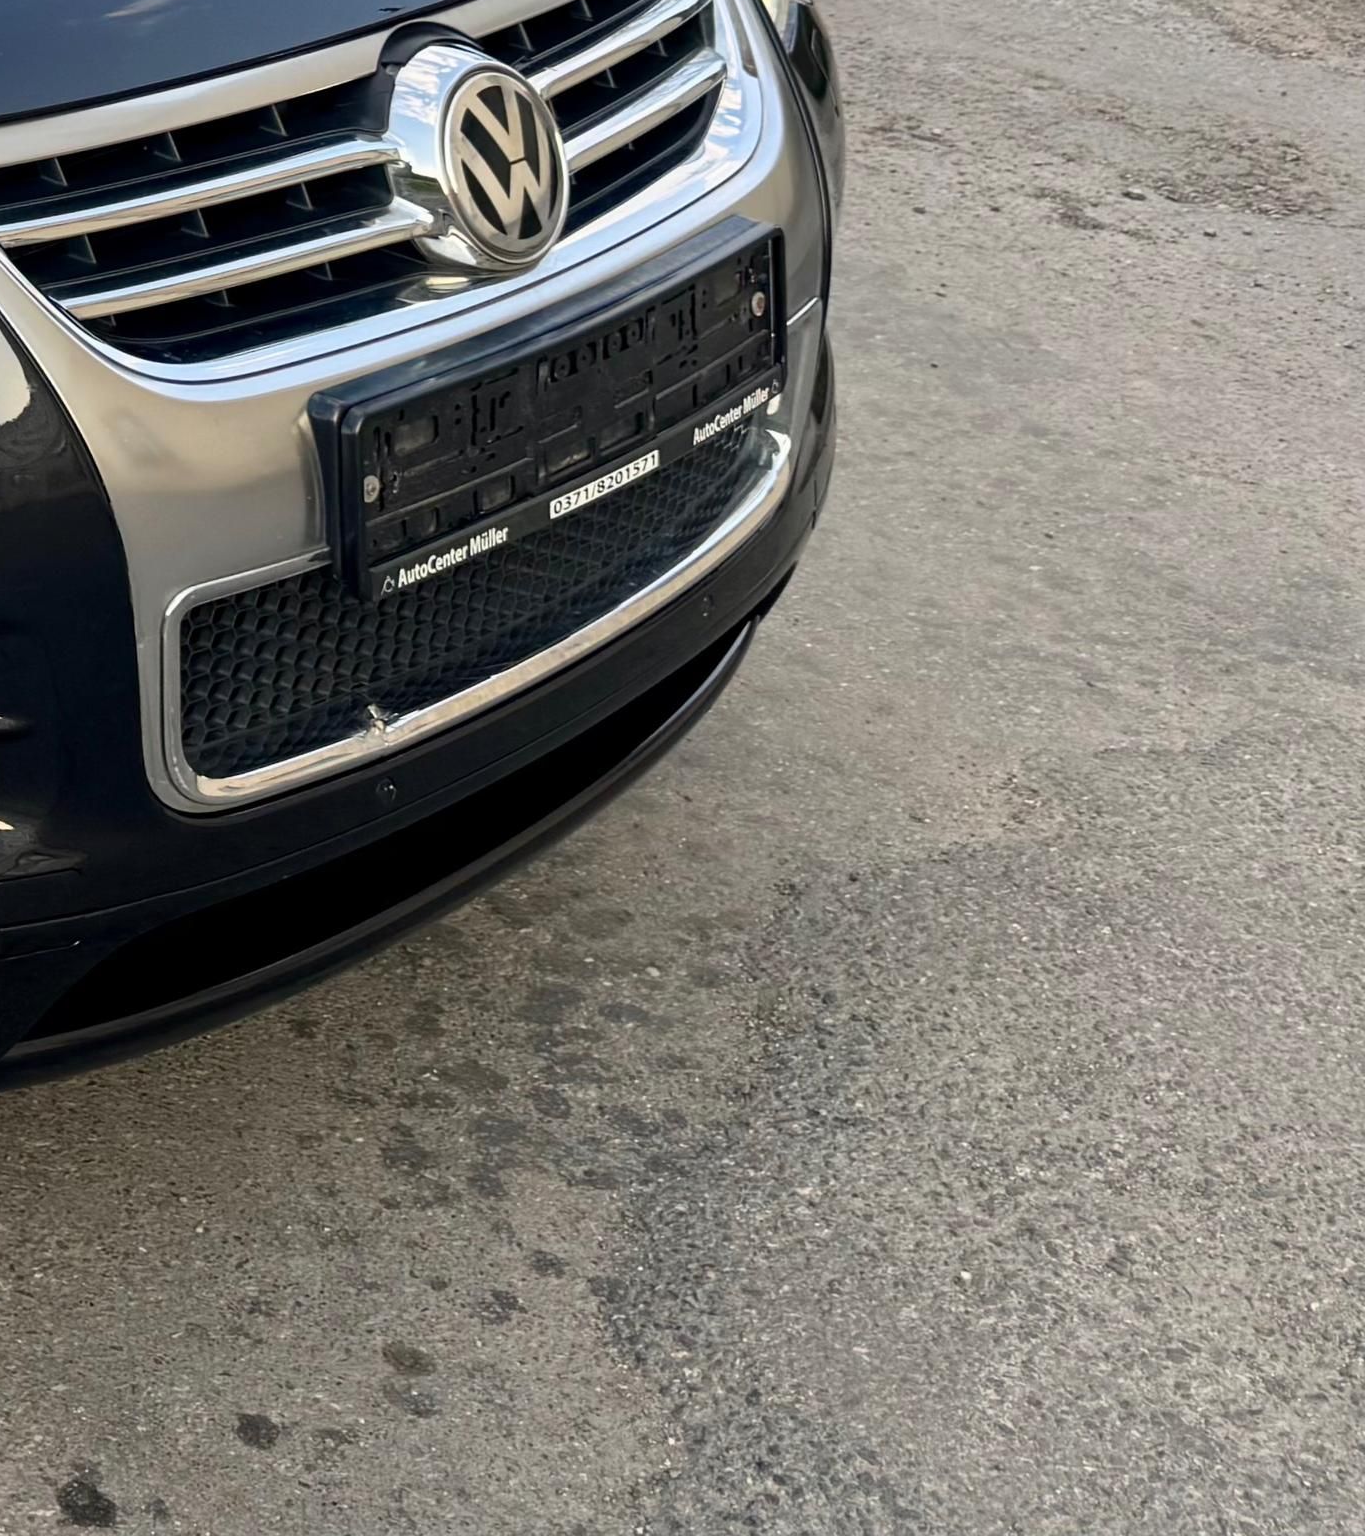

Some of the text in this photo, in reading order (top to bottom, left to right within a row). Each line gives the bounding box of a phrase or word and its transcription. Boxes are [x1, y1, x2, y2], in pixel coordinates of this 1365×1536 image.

[692, 386, 770, 446] AutoCenter Müller
[553, 453, 658, 515] 0371/8201571
[397, 525, 510, 589] AutoCenter Müller
